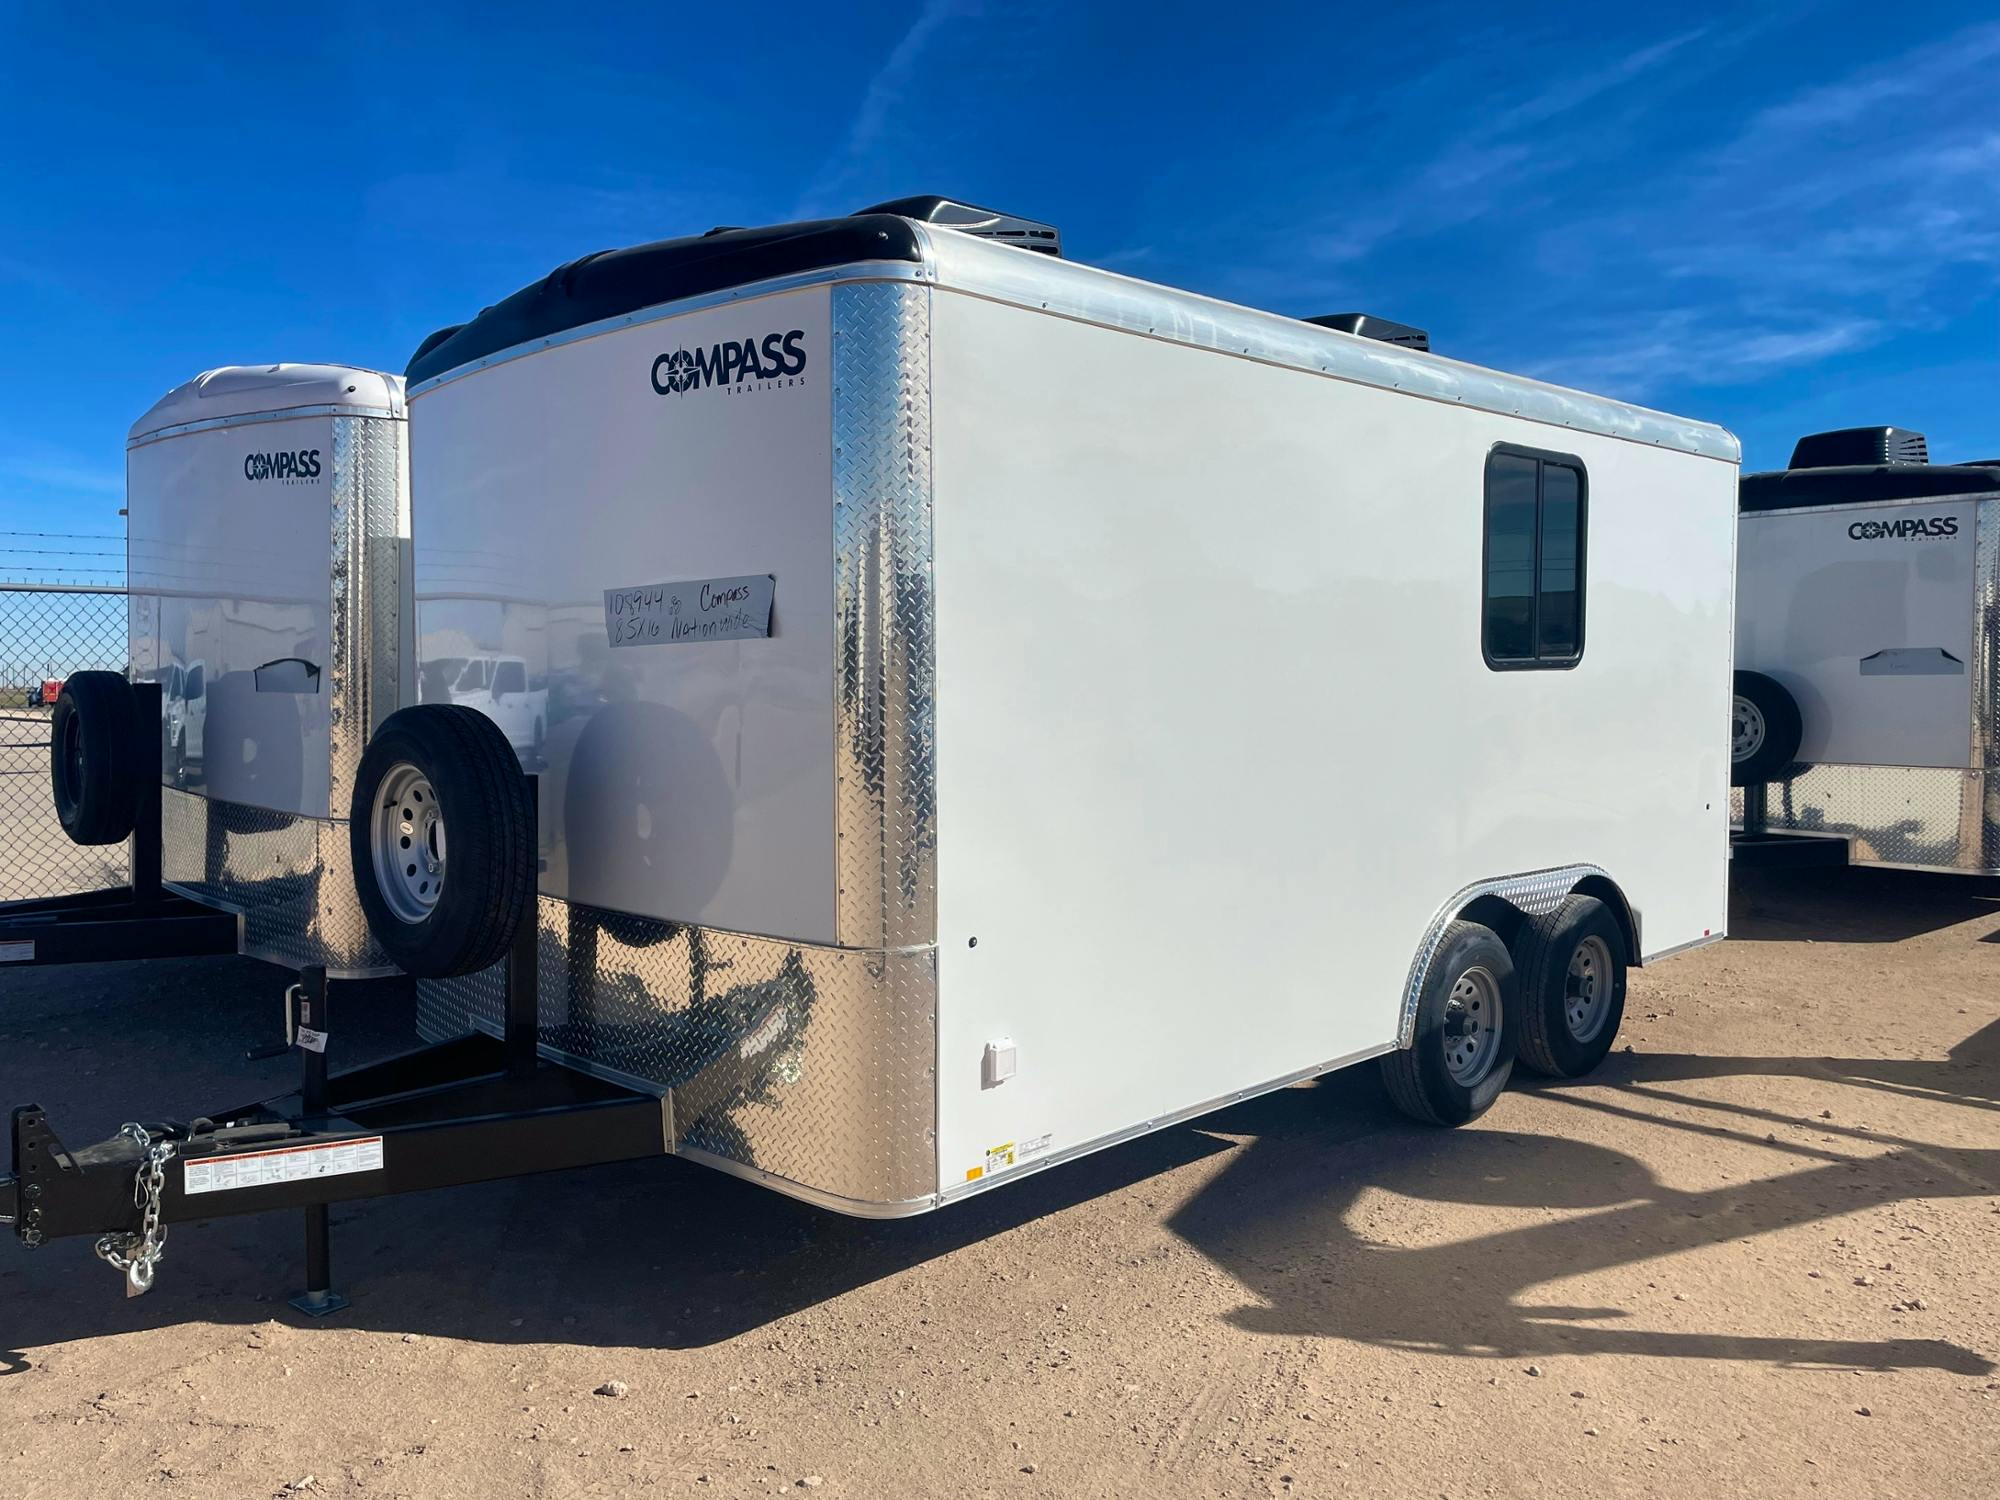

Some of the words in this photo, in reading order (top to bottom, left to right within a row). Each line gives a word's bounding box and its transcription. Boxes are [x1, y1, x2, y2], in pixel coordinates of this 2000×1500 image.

[651, 330, 807, 396] COMPASS
[727, 378, 805, 395] TRAILERS
[244, 450, 321, 481] COMPASS
[1848, 517, 1958, 540] COMPASS
[609, 589, 664, 615] 108944
[700, 584, 750, 611] Compass
